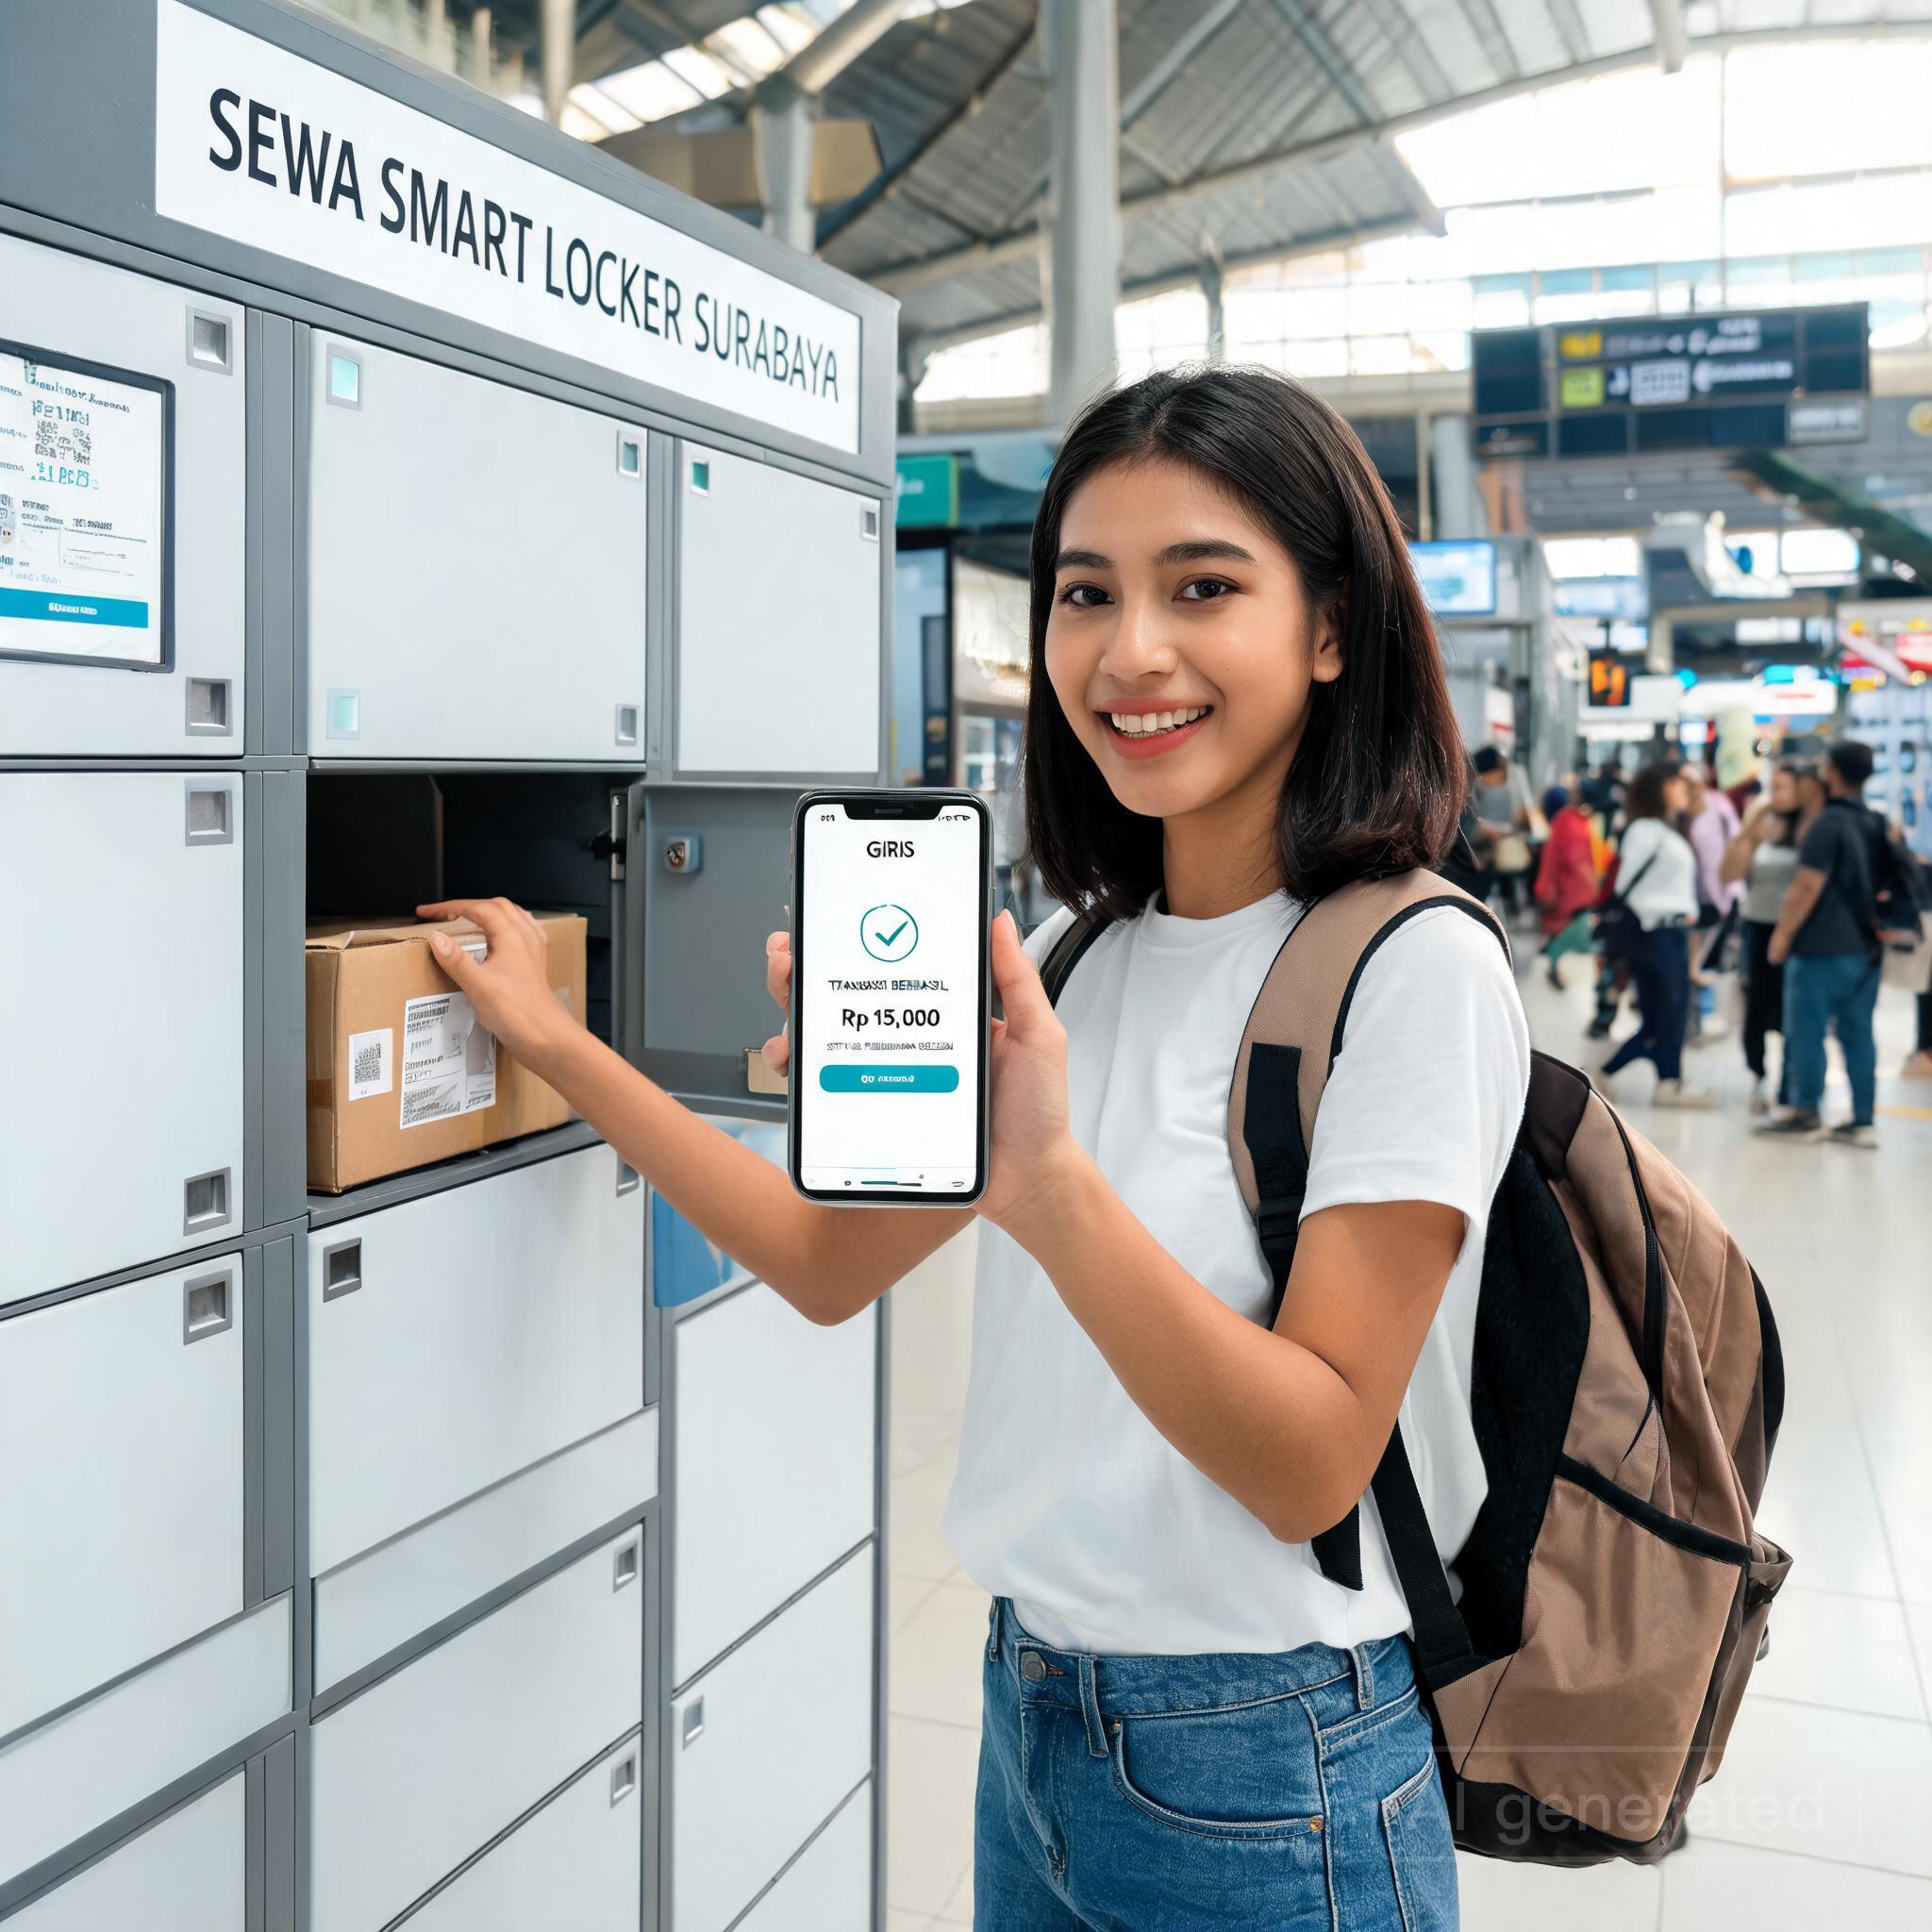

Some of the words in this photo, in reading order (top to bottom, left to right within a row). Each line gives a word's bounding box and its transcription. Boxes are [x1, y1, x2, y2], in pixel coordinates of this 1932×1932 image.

[208, 88, 365, 223] SEWA
[379, 157, 533, 284] SMART
[545, 225, 682, 344] LOCKER
[694, 292, 839, 402] SURABAYA
[866, 840, 915, 858] GIRIS
[841, 1008, 870, 1032] Rp
[874, 1008, 941, 1029] 15,000
